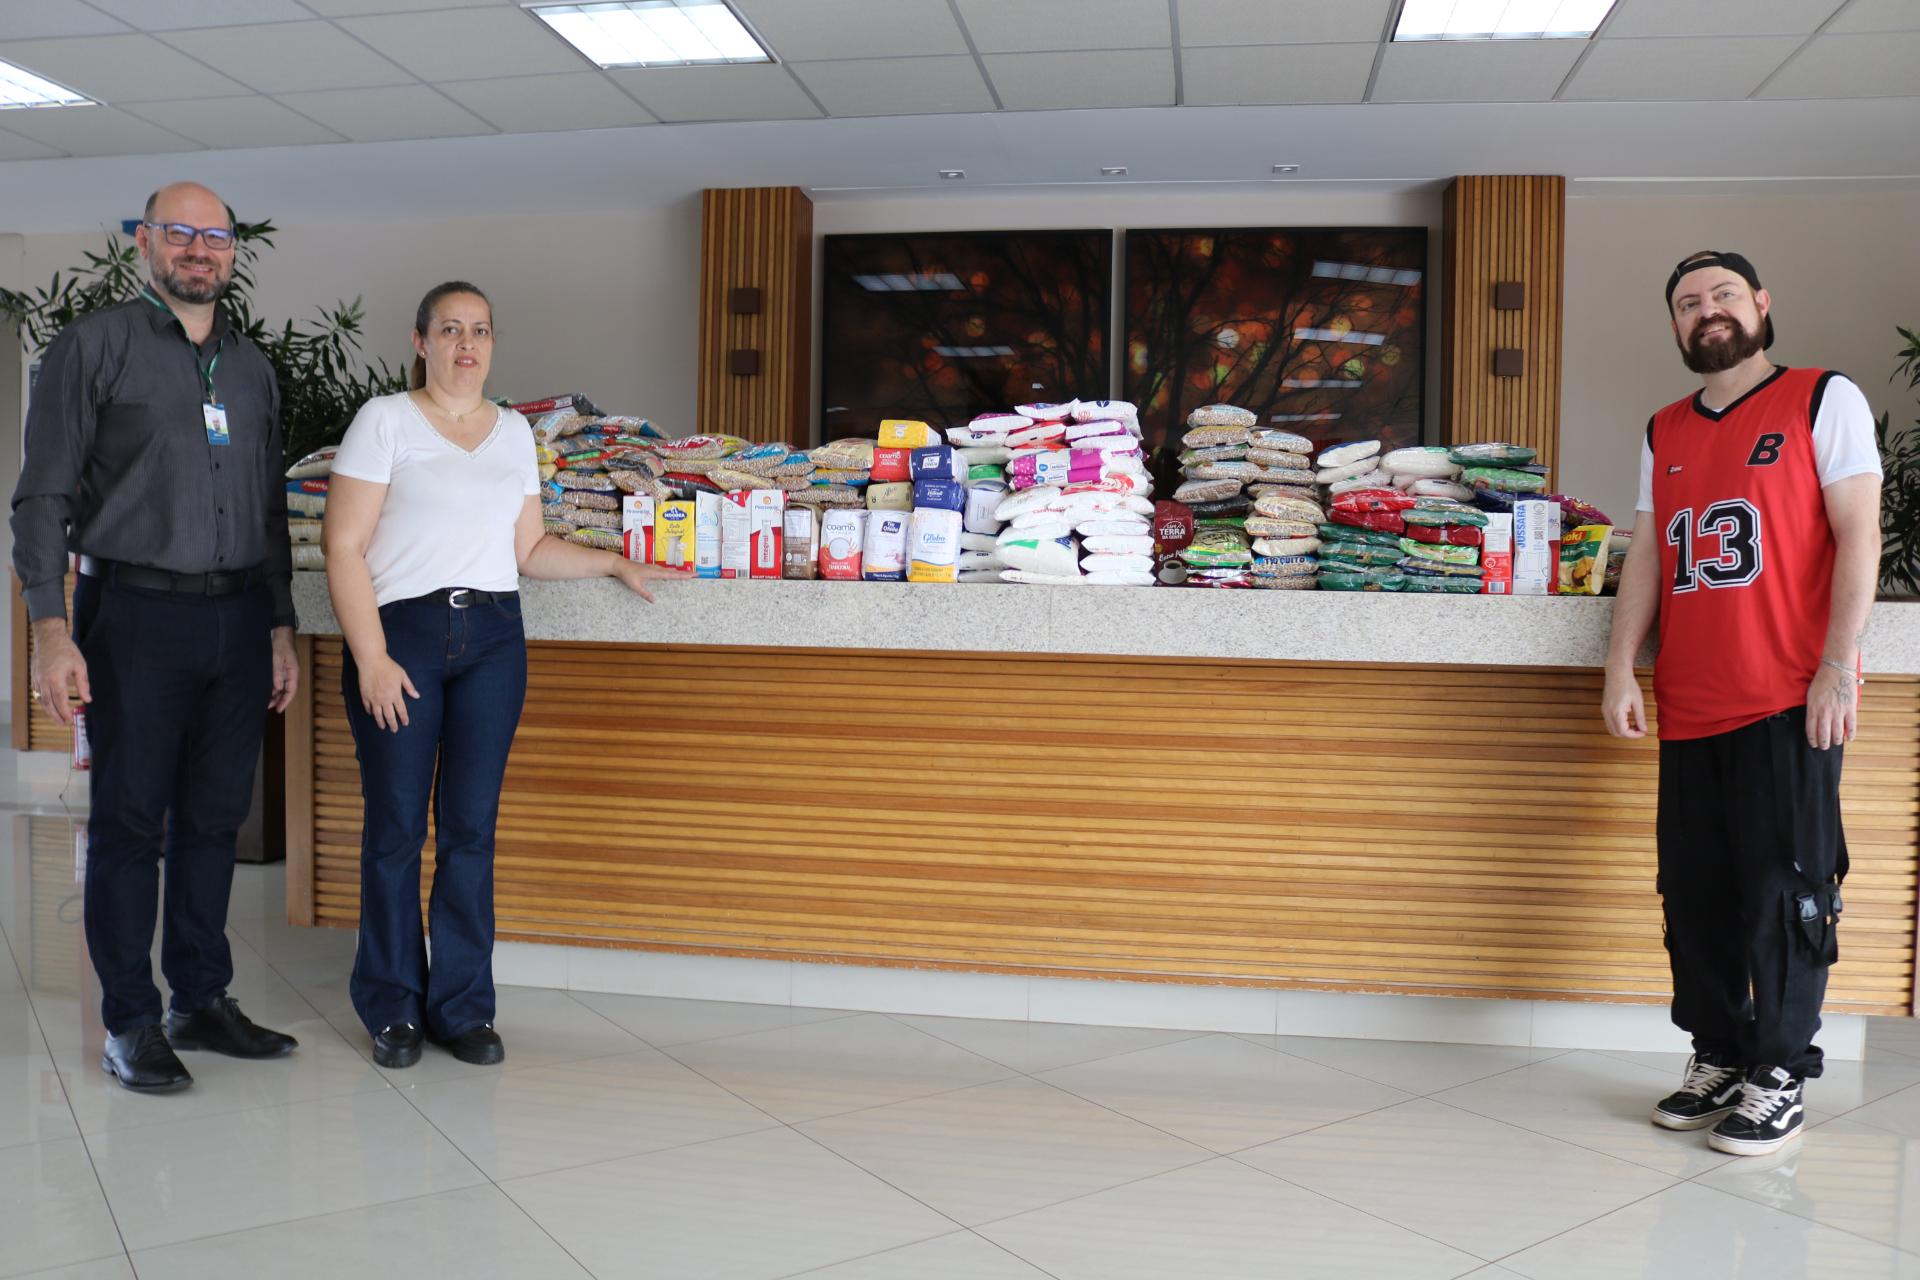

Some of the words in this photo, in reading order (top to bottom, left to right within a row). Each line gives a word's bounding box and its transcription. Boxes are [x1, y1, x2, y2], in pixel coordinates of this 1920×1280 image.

[1745, 432, 1785, 466] B
[1159, 528, 1186, 536] TERRA
[1516, 503, 1527, 548] JUSSARA
[1279, 556, 1305, 564] QUITO
[1666, 498, 1763, 594] 13
